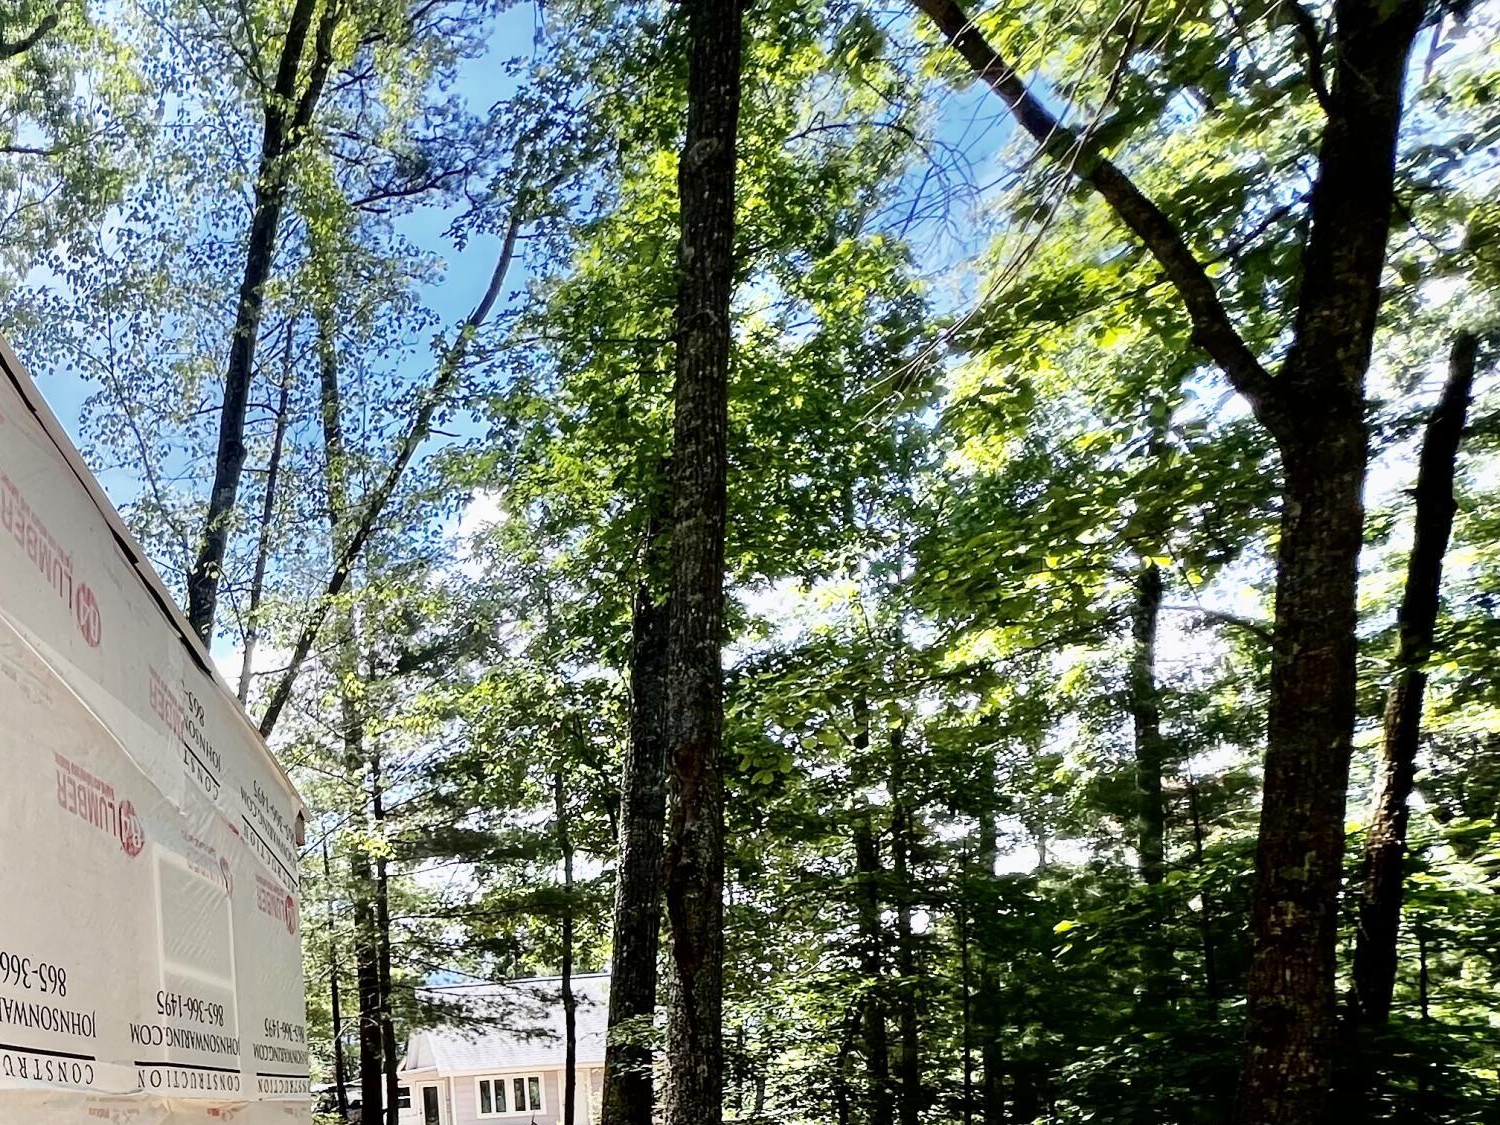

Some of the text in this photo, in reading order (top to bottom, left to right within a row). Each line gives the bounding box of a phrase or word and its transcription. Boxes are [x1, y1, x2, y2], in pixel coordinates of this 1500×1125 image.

[1, 488, 73, 610] LUMBER
[56, 769, 116, 837] LUMBER
[156, 990, 224, 1027] 865-366-1495
[128, 1023, 241, 1057] JOHNSONWARING.COM
[136, 1069, 240, 1092] CONSTRUCTION
